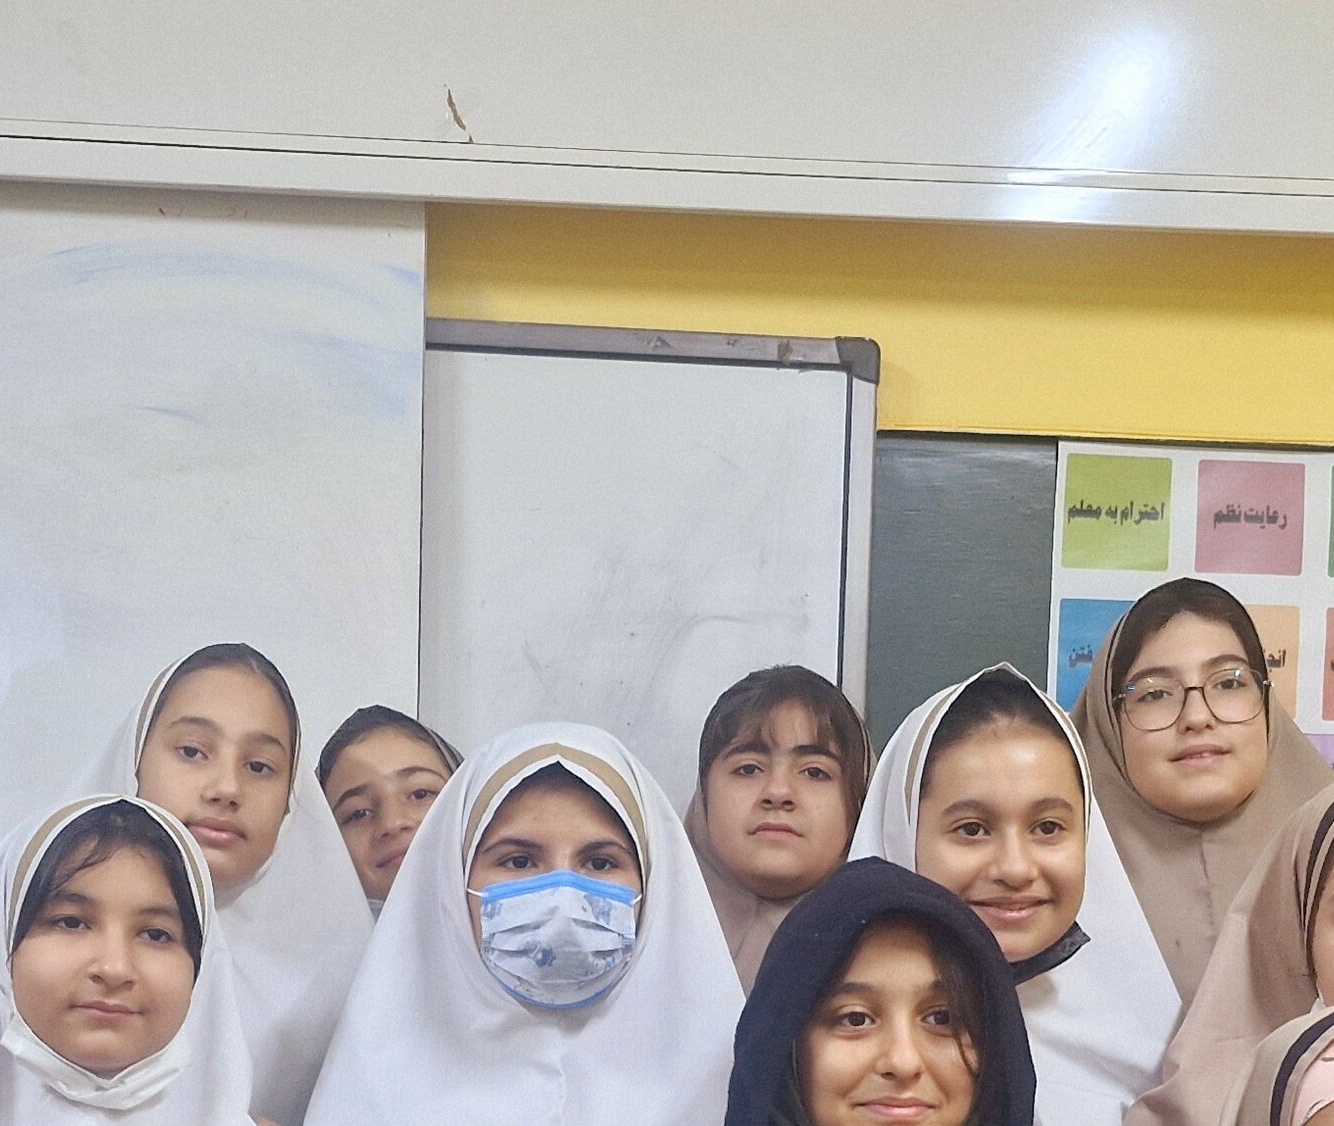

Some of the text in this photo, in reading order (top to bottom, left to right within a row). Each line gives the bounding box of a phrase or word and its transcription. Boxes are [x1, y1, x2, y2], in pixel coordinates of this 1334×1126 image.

[1068, 500, 1165, 525] احترام به معلم
[1214, 504, 1287, 530] رعایت نظم
[1266, 649, 1287, 672] انج
